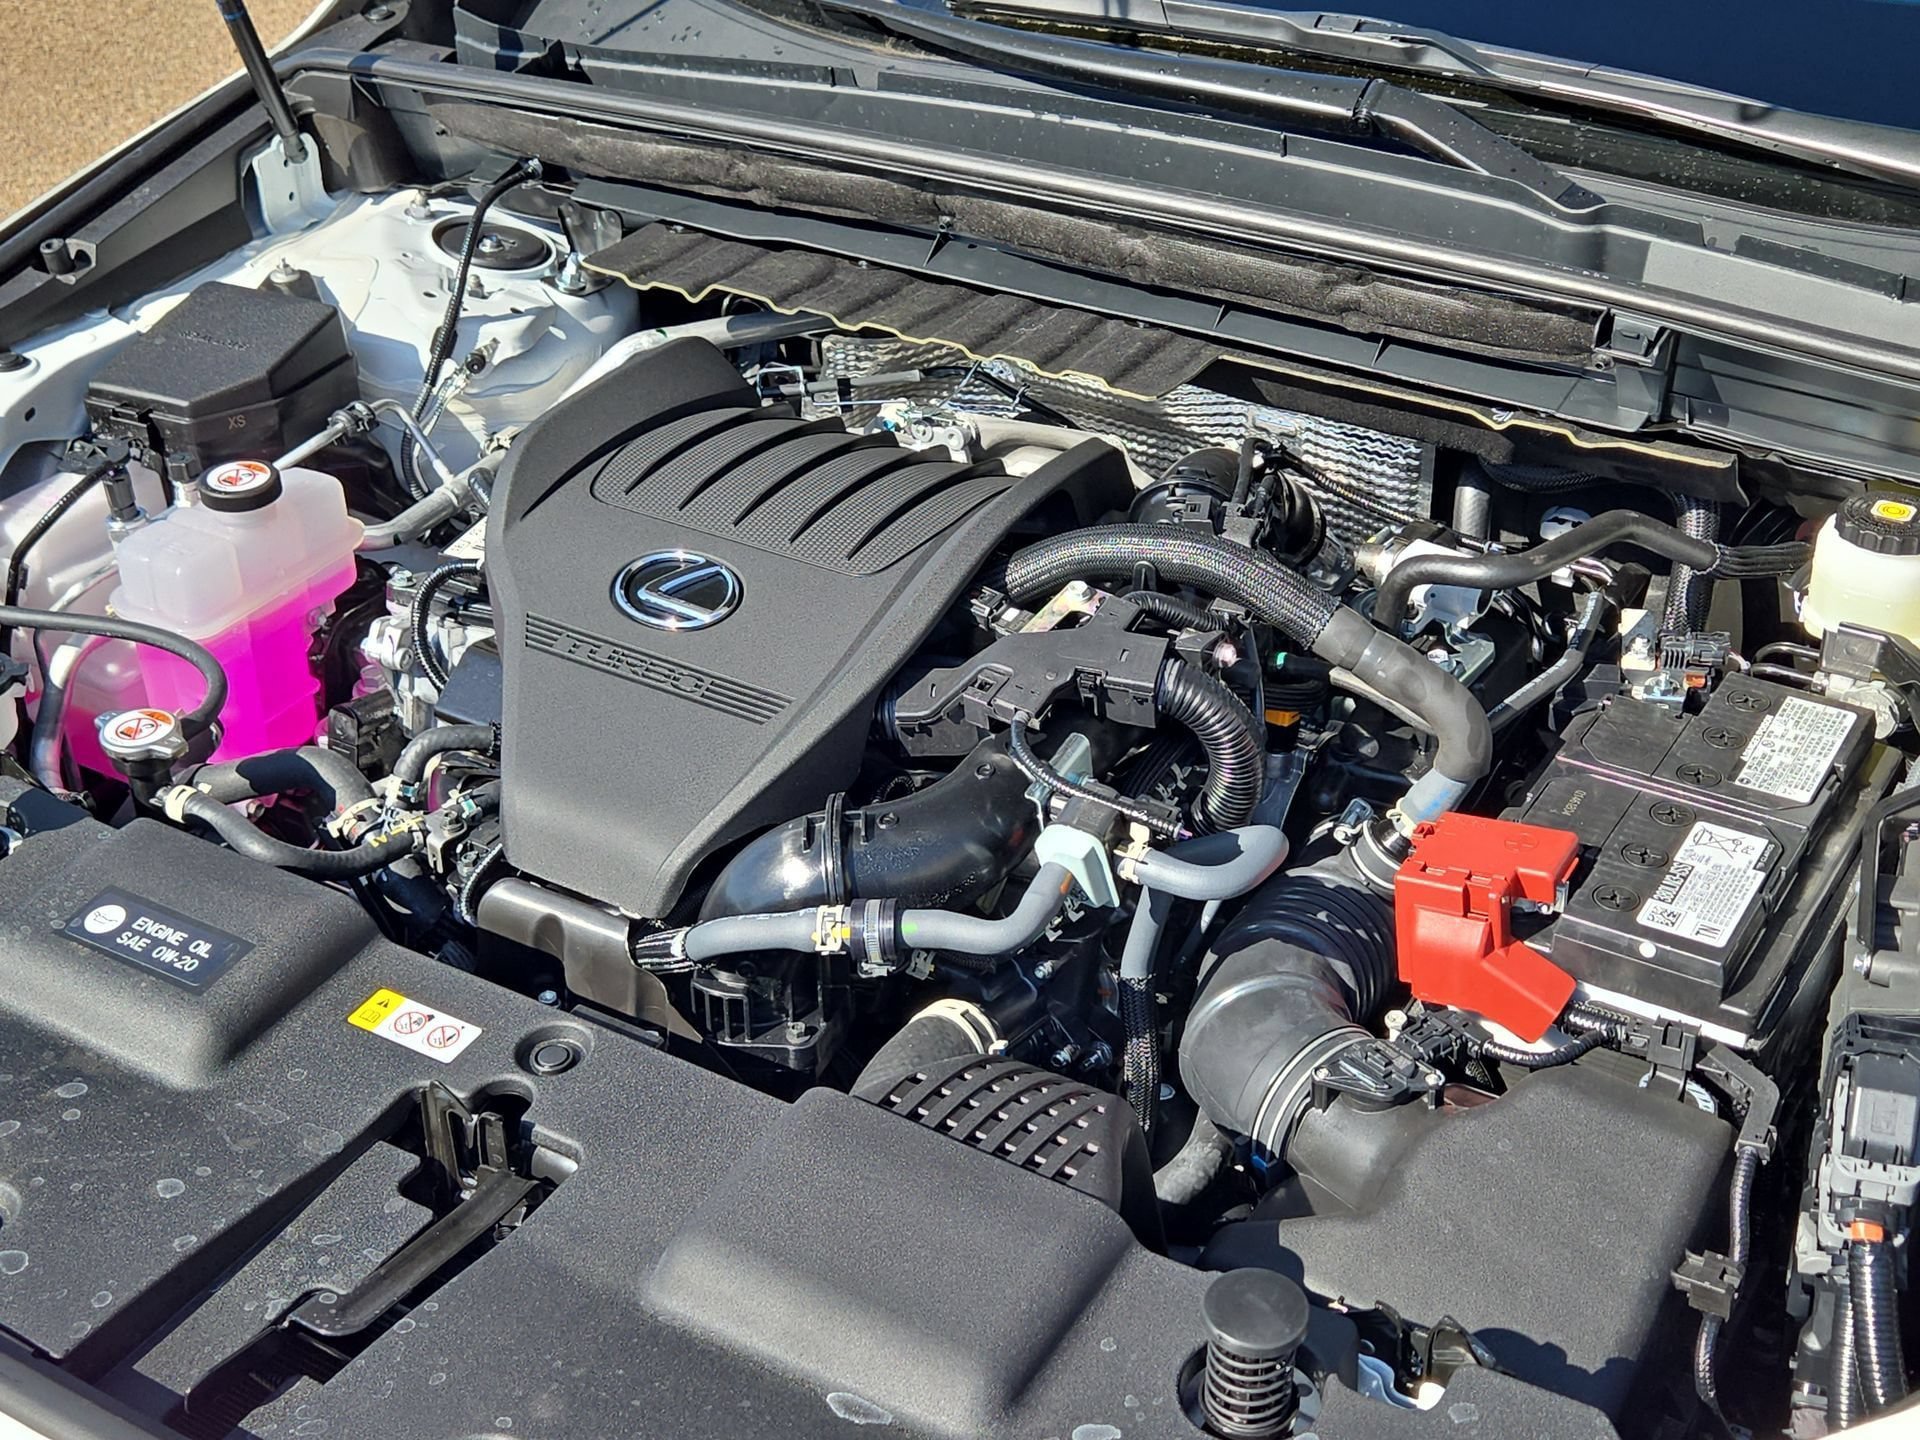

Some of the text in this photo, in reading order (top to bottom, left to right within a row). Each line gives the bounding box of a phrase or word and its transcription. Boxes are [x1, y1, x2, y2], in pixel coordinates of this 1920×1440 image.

[228, 414, 247, 431] XS
[566, 632, 704, 693] TURBO
[116, 931, 199, 972] SAE 0W-20
[131, 916, 213, 959] ENGINE OIL
